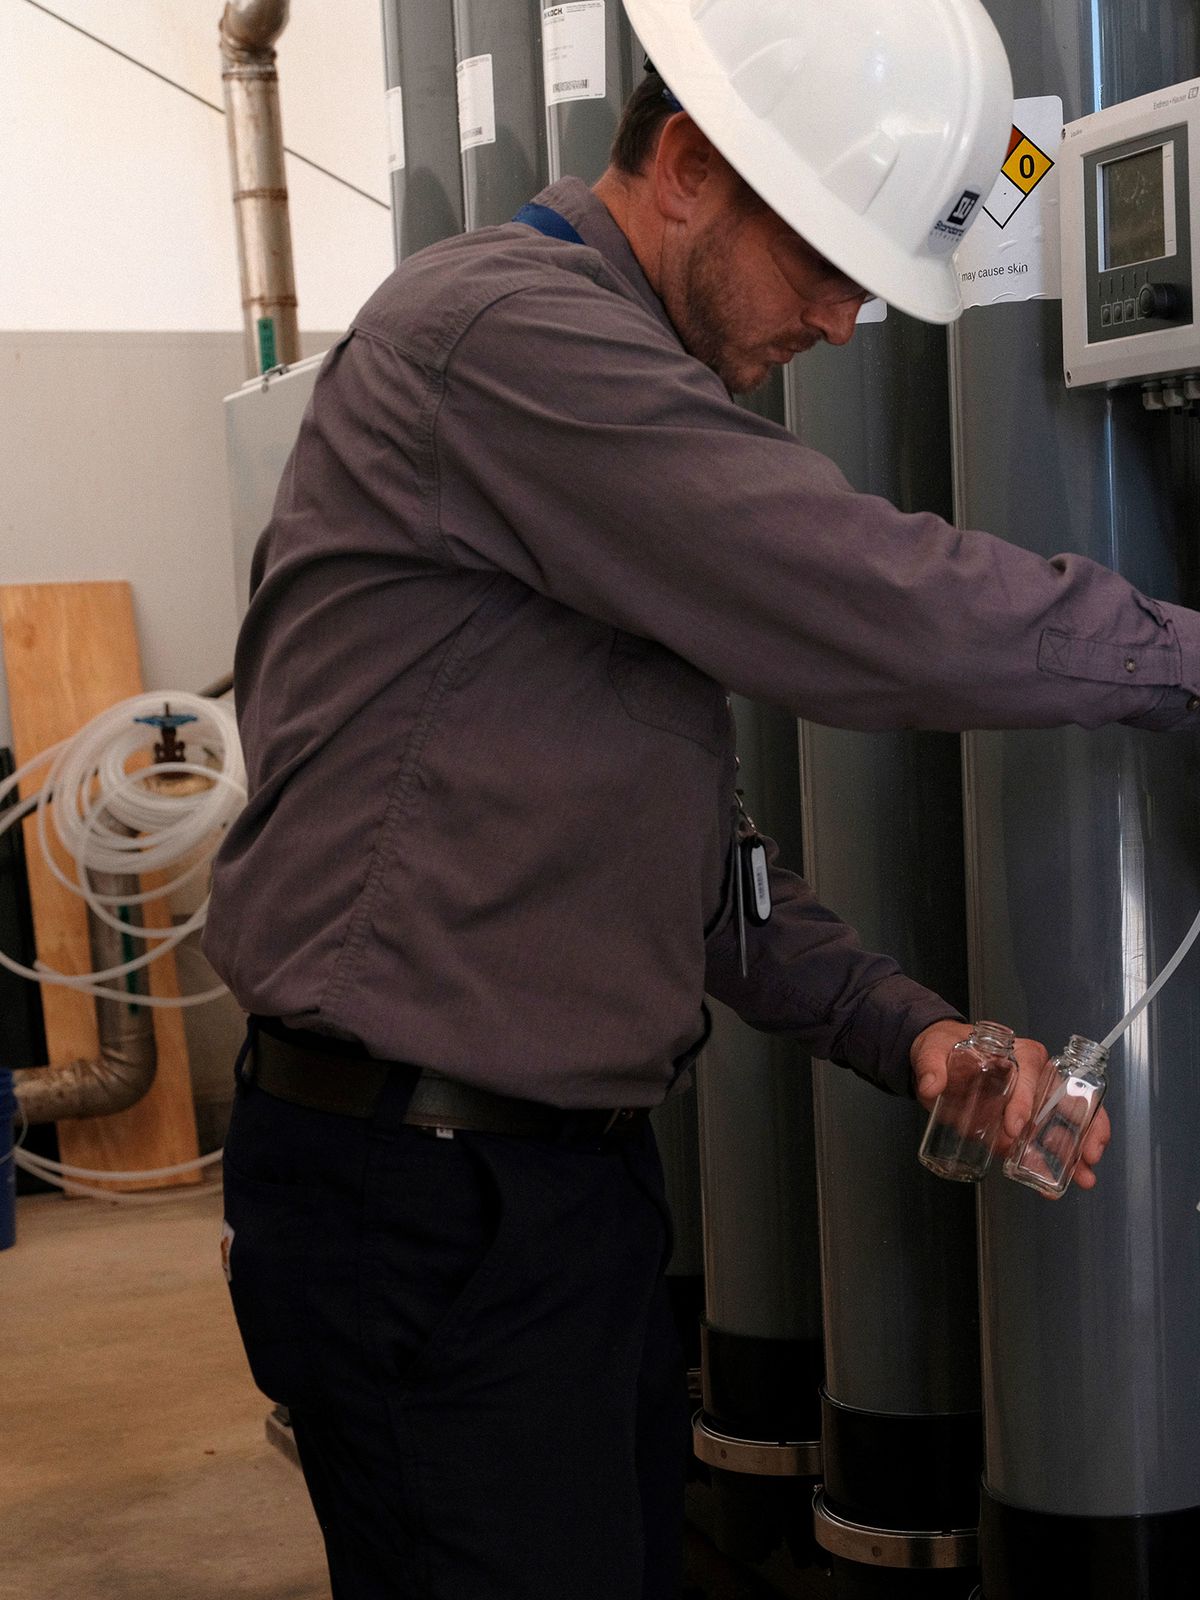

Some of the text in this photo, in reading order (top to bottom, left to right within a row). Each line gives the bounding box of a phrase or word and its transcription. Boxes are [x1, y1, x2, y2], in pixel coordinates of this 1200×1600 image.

[1019, 154, 1035, 179] 0
[961, 262, 1029, 283] may cause skin
